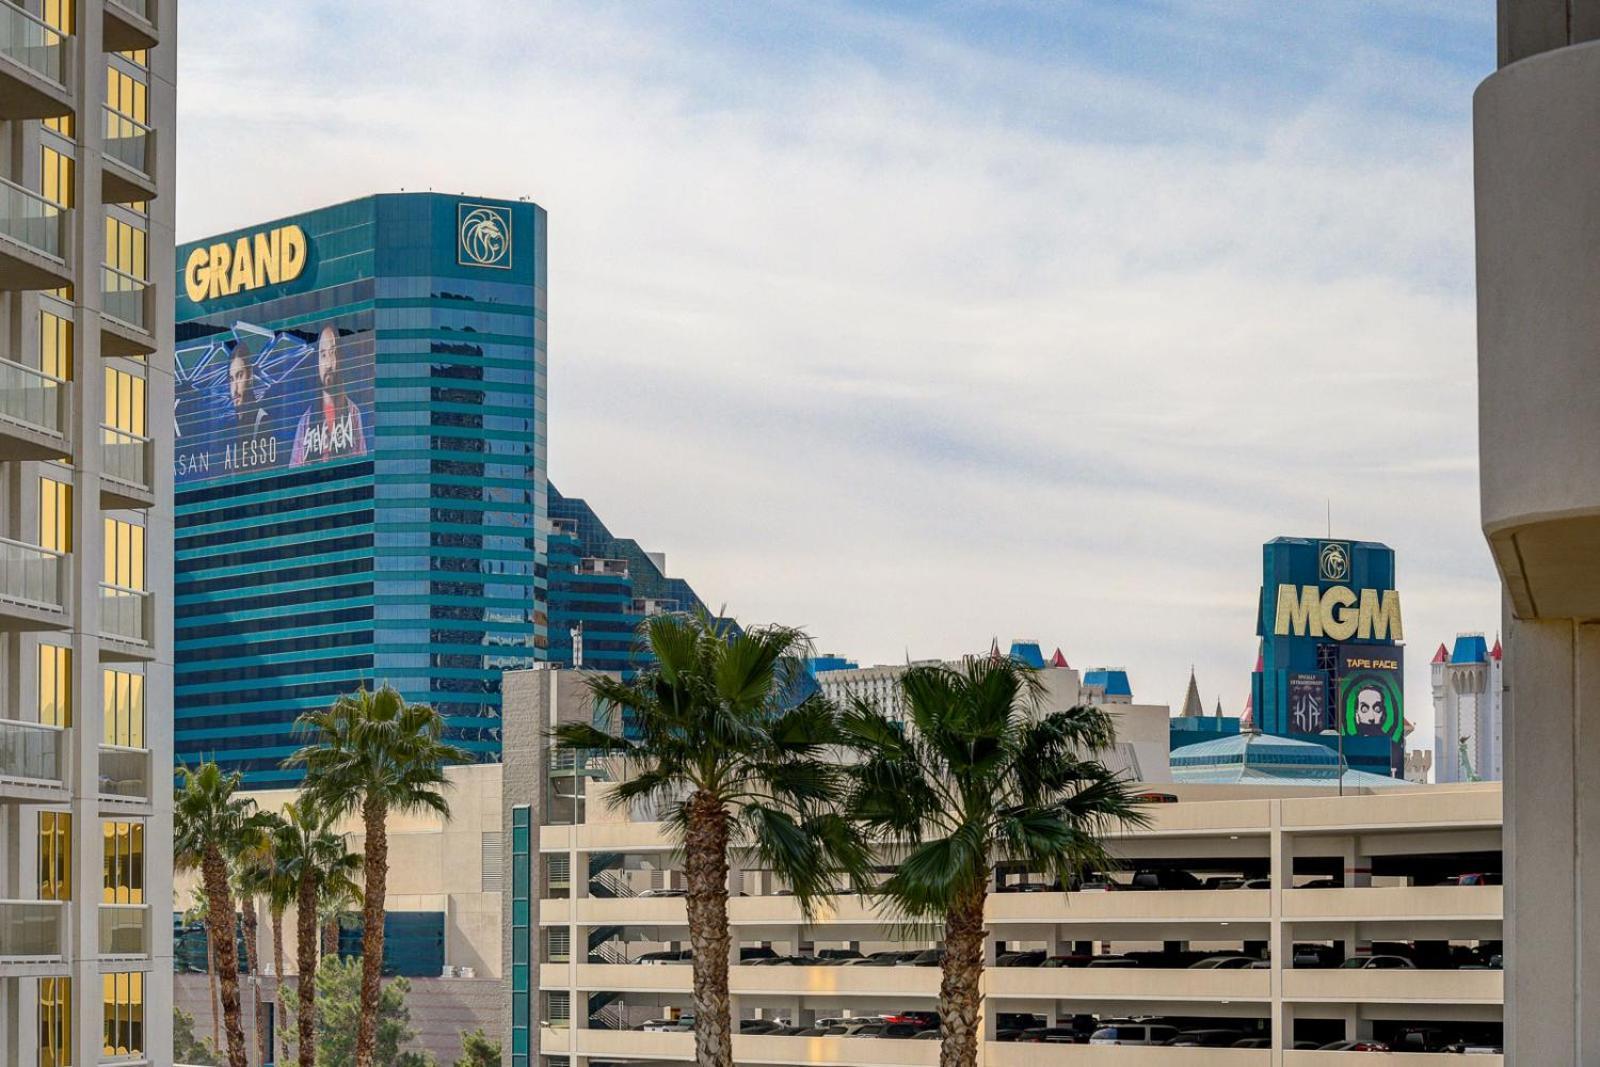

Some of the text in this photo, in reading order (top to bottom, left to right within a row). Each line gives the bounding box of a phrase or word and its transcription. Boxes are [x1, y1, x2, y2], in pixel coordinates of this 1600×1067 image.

[185, 225, 307, 302] GRAND
[224, 437, 277, 470] ALESSO
[1274, 583, 1403, 641] MGM
[1346, 659, 1398, 670] TAPE FACE
